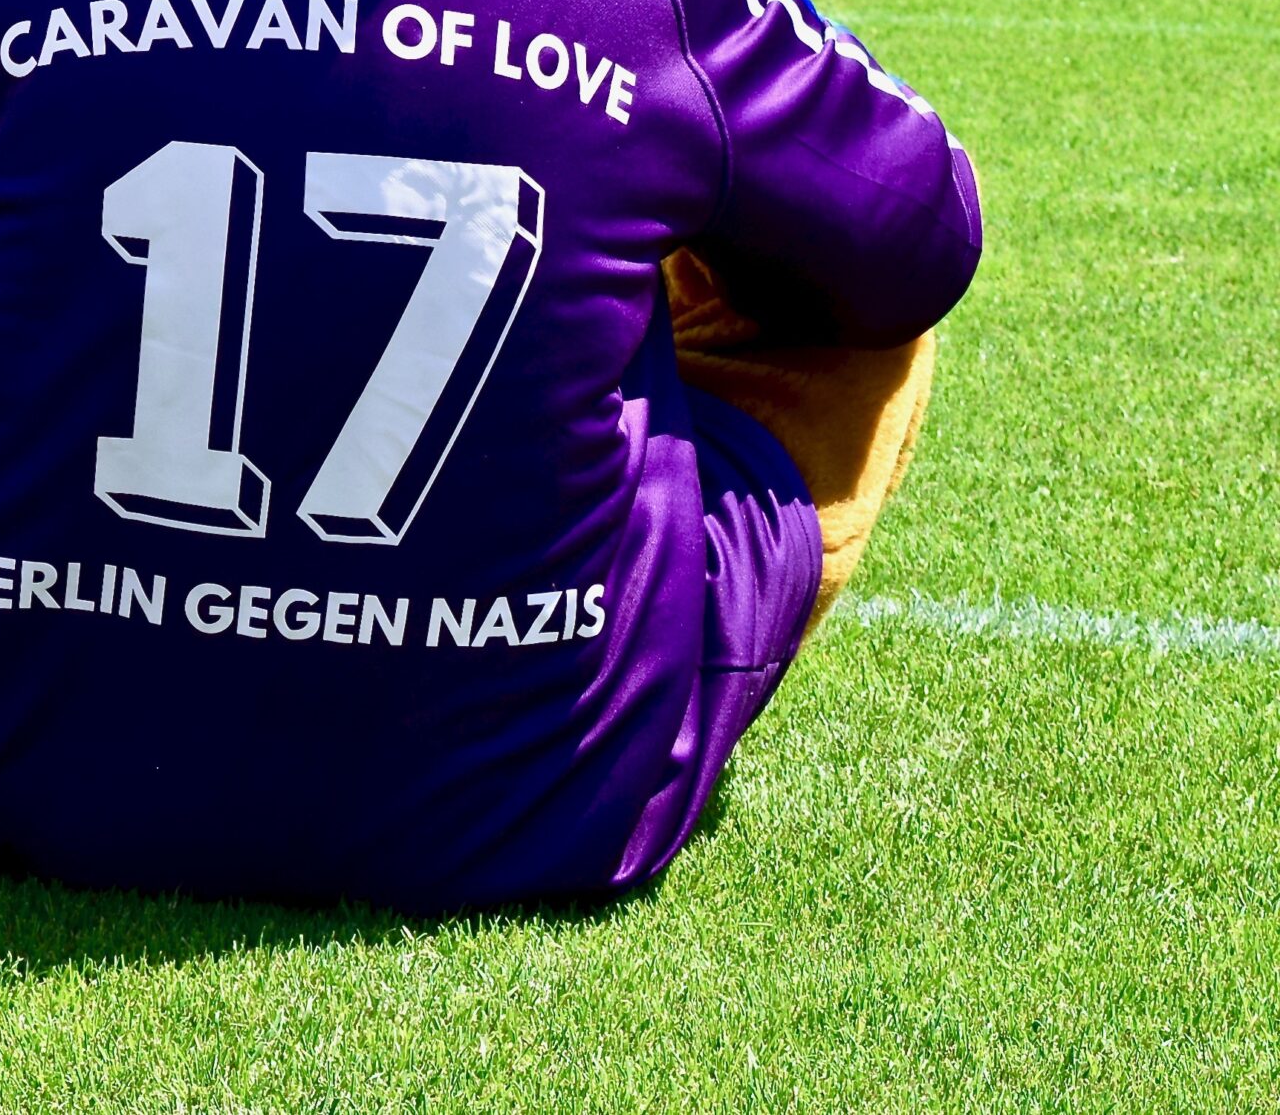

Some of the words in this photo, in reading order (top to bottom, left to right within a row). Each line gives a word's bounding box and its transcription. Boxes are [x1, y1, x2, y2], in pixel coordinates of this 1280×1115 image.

[381, 4, 475, 66] OF
[493, 19, 637, 126] LOVE
[94, 140, 546, 547] 17
[184, 582, 410, 647] GEGEN
[425, 584, 606, 648] NAZIS
